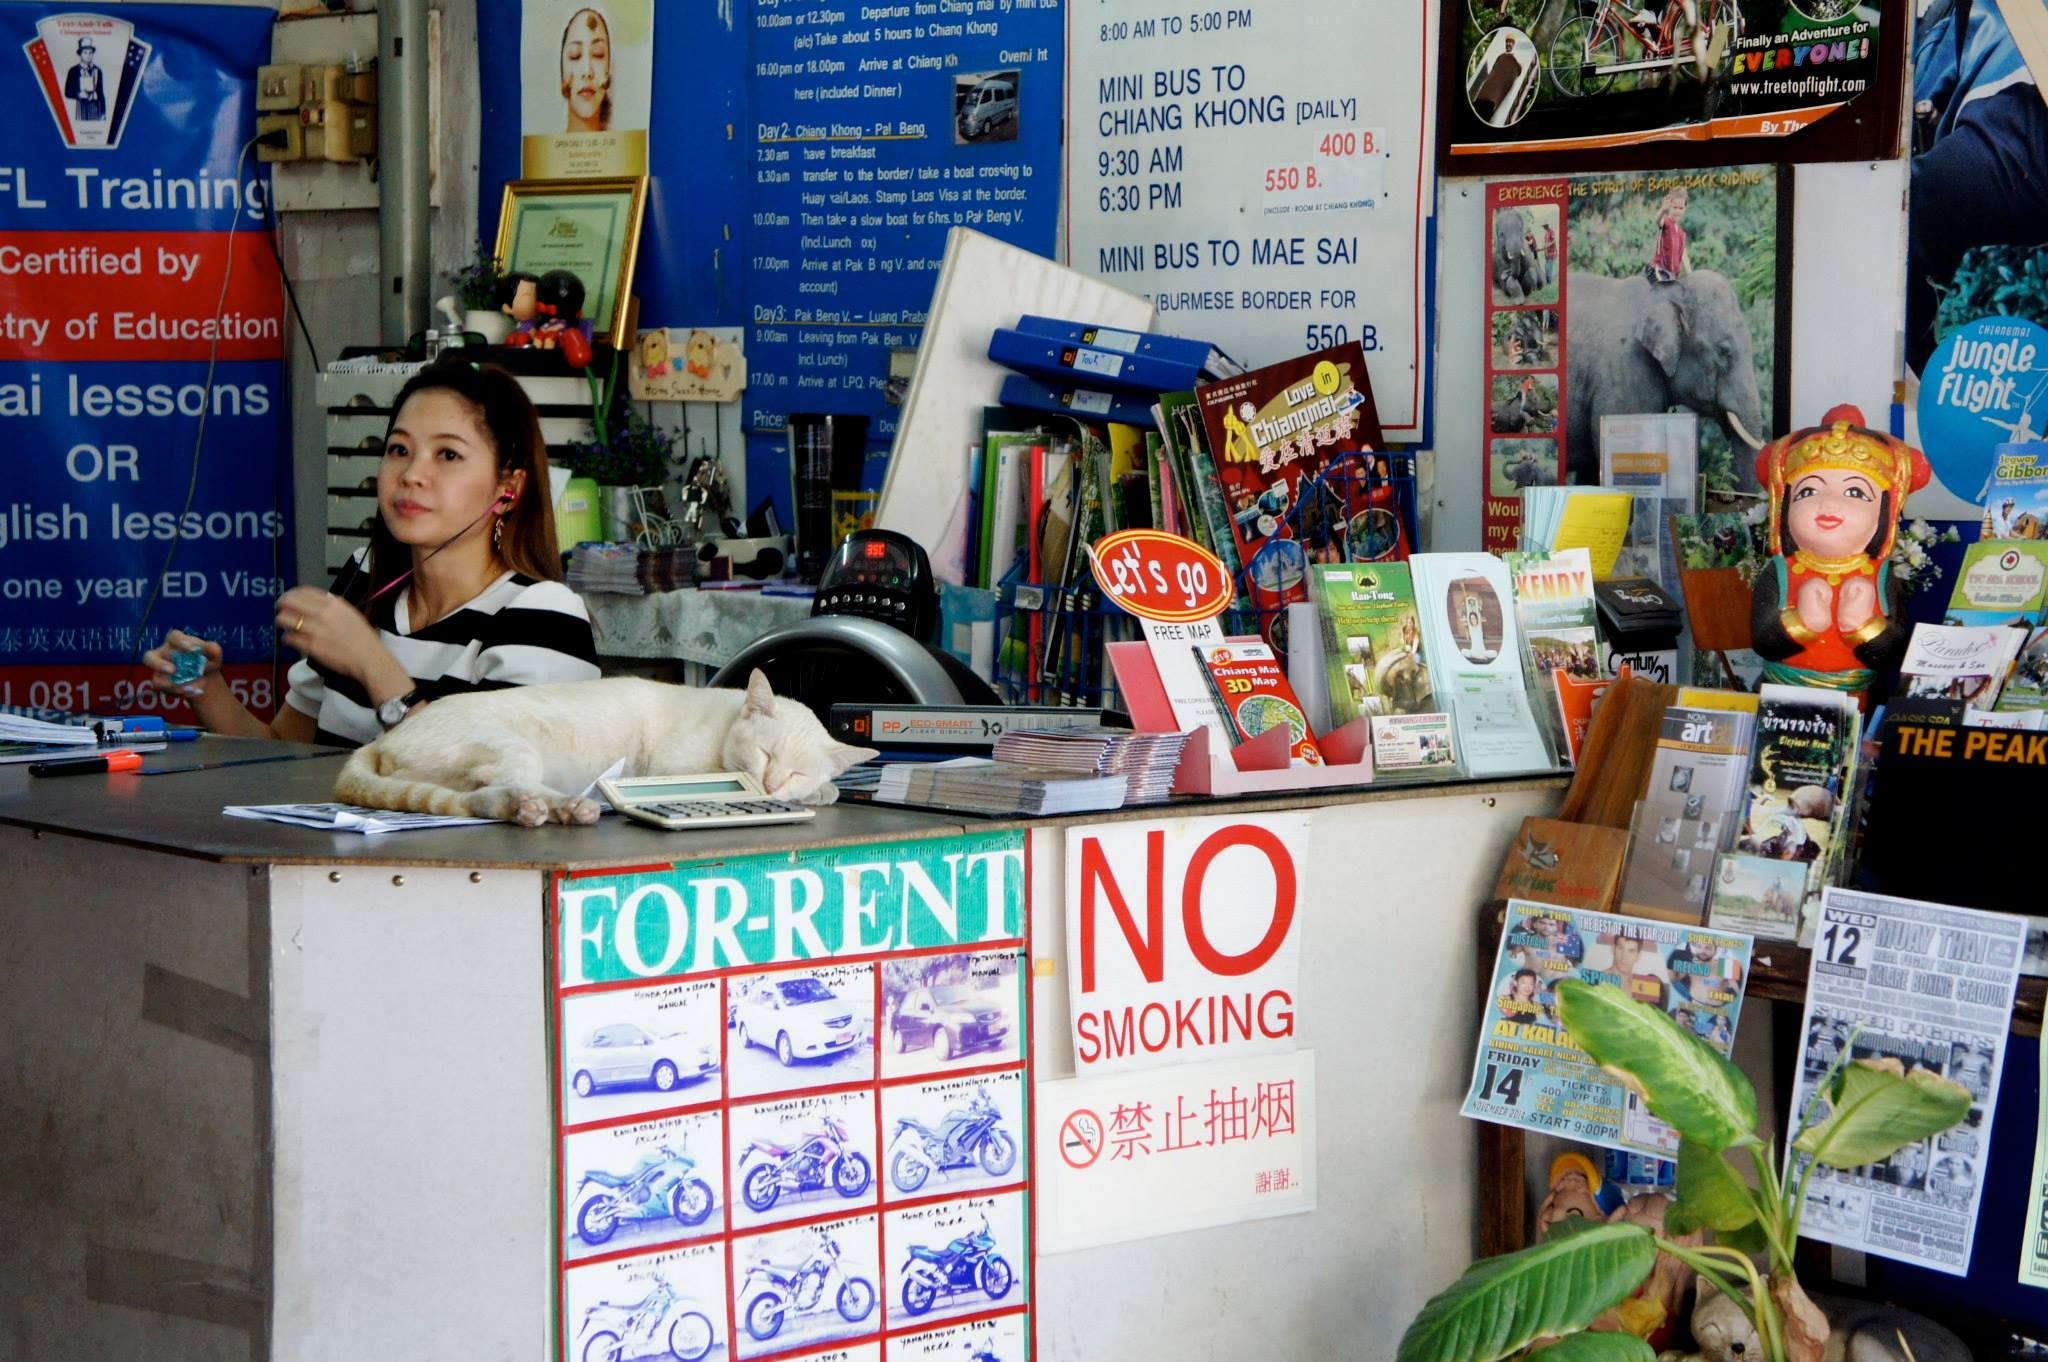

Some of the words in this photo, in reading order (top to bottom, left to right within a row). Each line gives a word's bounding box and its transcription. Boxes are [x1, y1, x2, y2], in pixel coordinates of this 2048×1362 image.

[807, 10, 845, 25] 12.30pm
[861, 5, 910, 21] Departure
[915, 2, 936, 15] from
[1100, 23, 1128, 41] 8:00
[1133, 20, 1155, 39] AM
[1161, 16, 1182, 35] TO
[1190, 12, 1221, 32] 5:00
[1227, 9, 1251, 28] PM
[815, 32, 838, 46] Take
[842, 30, 870, 44] about
[875, 28, 881, 41] 5
[884, 26, 912, 40] hours
[915, 26, 925, 38] to
[966, 21, 998, 37] Khong
[1736, 34, 1772, 49] Finally
[1774, 33, 1788, 44] an
[1791, 25, 1850, 42] Adventure
[1853, 22, 1869, 36] for
[807, 60, 845, 75] 18.00pm
[859, 58, 888, 72] Arrive
[892, 58, 903, 70] at
[908, 55, 942, 70] Chiang
[1733, 38, 1870, 75] EVERYONE!
[1100, 74, 1143, 104] MINI
[1154, 68, 1201, 97] BUS
[1212, 65, 1245, 92] TO
[1731, 76, 1865, 97] www.treetopflight.com
[1100, 104, 1182, 137] CHIANG
[1195, 95, 1285, 128] KHONG
[1760, 121, 1778, 134] By
[831, 124, 862, 139] Khong
[1320, 133, 1356, 157] 400
[1363, 131, 1380, 154] B.
[803, 147, 825, 159] have
[831, 145, 876, 158] breakfast
[1099, 150, 1140, 177] 9:30
[1149, 146, 1183, 173] AM
[803, 168, 837, 182] transfer
[844, 170, 854, 181] to
[858, 168, 873, 180] the
[918, 166, 939, 179] take
[944, 168, 950, 178] a
[954, 165, 974, 178] boat
[1022, 164, 1033, 177] to
[1265, 167, 1299, 191] 550
[1306, 166, 1322, 187] B.
[1498, 184, 1564, 201] EXPERIENCE
[1568, 182, 1588, 196] THE
[1631, 177, 1644, 192] OF
[1720, 170, 1761, 186] RIDING
[65, 168, 273, 219] Training
[876, 190, 907, 205] Stamp
[911, 190, 934, 203] Laos
[962, 188, 972, 200] at
[976, 188, 991, 200] the
[1100, 184, 1140, 211] 6:30
[1149, 182, 1182, 208] PM
[861, 213, 883, 226] slow
[886, 212, 908, 226] boat
[912, 211, 925, 225] for
[986, 208, 1011, 226] Beng
[0, 246, 141, 275] Certified
[158, 248, 199, 281] by
[801, 258, 828, 271] Arrive
[832, 258, 841, 271] at
[845, 258, 863, 271] Pak
[1100, 246, 1144, 273] MINI
[1154, 243, 1199, 269] BUS
[1208, 240, 1240, 266] TO
[1252, 239, 1305, 265] MAE
[1317, 237, 1357, 264] SAI
[799, 281, 838, 296] account)
[795, 310, 811, 322] Pak
[816, 309, 840, 323] Beng
[869, 310, 897, 324] Luang
[1155, 291, 1235, 316] (BURMESE
[1242, 291, 1312, 309] BORDER
[1320, 290, 1356, 308] FOR
[65, 313, 98, 340] of
[113, 314, 278, 340] Education
[799, 331, 834, 346] Leaving
[837, 331, 857, 344] from
[862, 332, 878, 345] Pak
[1306, 325, 1347, 350] 550
[1362, 325, 1384, 351] B.
[1942, 336, 2036, 375] jungle
[1322, 373, 1332, 385] in
[0, 375, 41, 416] ai
[69, 374, 270, 417] lessons
[1285, 382, 1315, 407] Love
[1937, 373, 2016, 413] flight
[1250, 396, 1337, 448] Chiangmai
[66, 444, 140, 482] OR
[112, 503, 284, 540] lessons
[1488, 525, 1509, 541] my
[1083, 540, 1168, 597] Let's
[3, 579, 62, 599] one
[77, 578, 147, 604] year
[162, 572, 208, 598] ED
[221, 571, 285, 597] Visa
[1516, 571, 1586, 602] KENDY
[1153, 624, 1184, 641] FREE
[1187, 624, 1212, 640] MAP
[1214, 666, 1257, 677] Chiang
[1259, 665, 1280, 675] Mai
[1225, 678, 1253, 694] 3D
[1252, 677, 1278, 687] Map
[910, 719, 974, 728] ECO-SMART
[1897, 726, 1957, 758] THE
[1964, 731, 2048, 765] PEAK
[560, 848, 1024, 989] FOR-RENT
[1082, 824, 1297, 994] NO
[1827, 909, 1876, 927] WED
[1823, 924, 1861, 965] 12
[1077, 989, 1295, 1065] SMOKING
[1488, 1050, 1541, 1069] FRIDAY
[1478, 1063, 1524, 1107] 14
[1561, 1079, 1608, 1095] TICKETS
[1109, 1079, 1296, 1162] 禁止抽烟
[1529, 1112, 1571, 1130] START
[1574, 1122, 1619, 1140] 9:00PM
